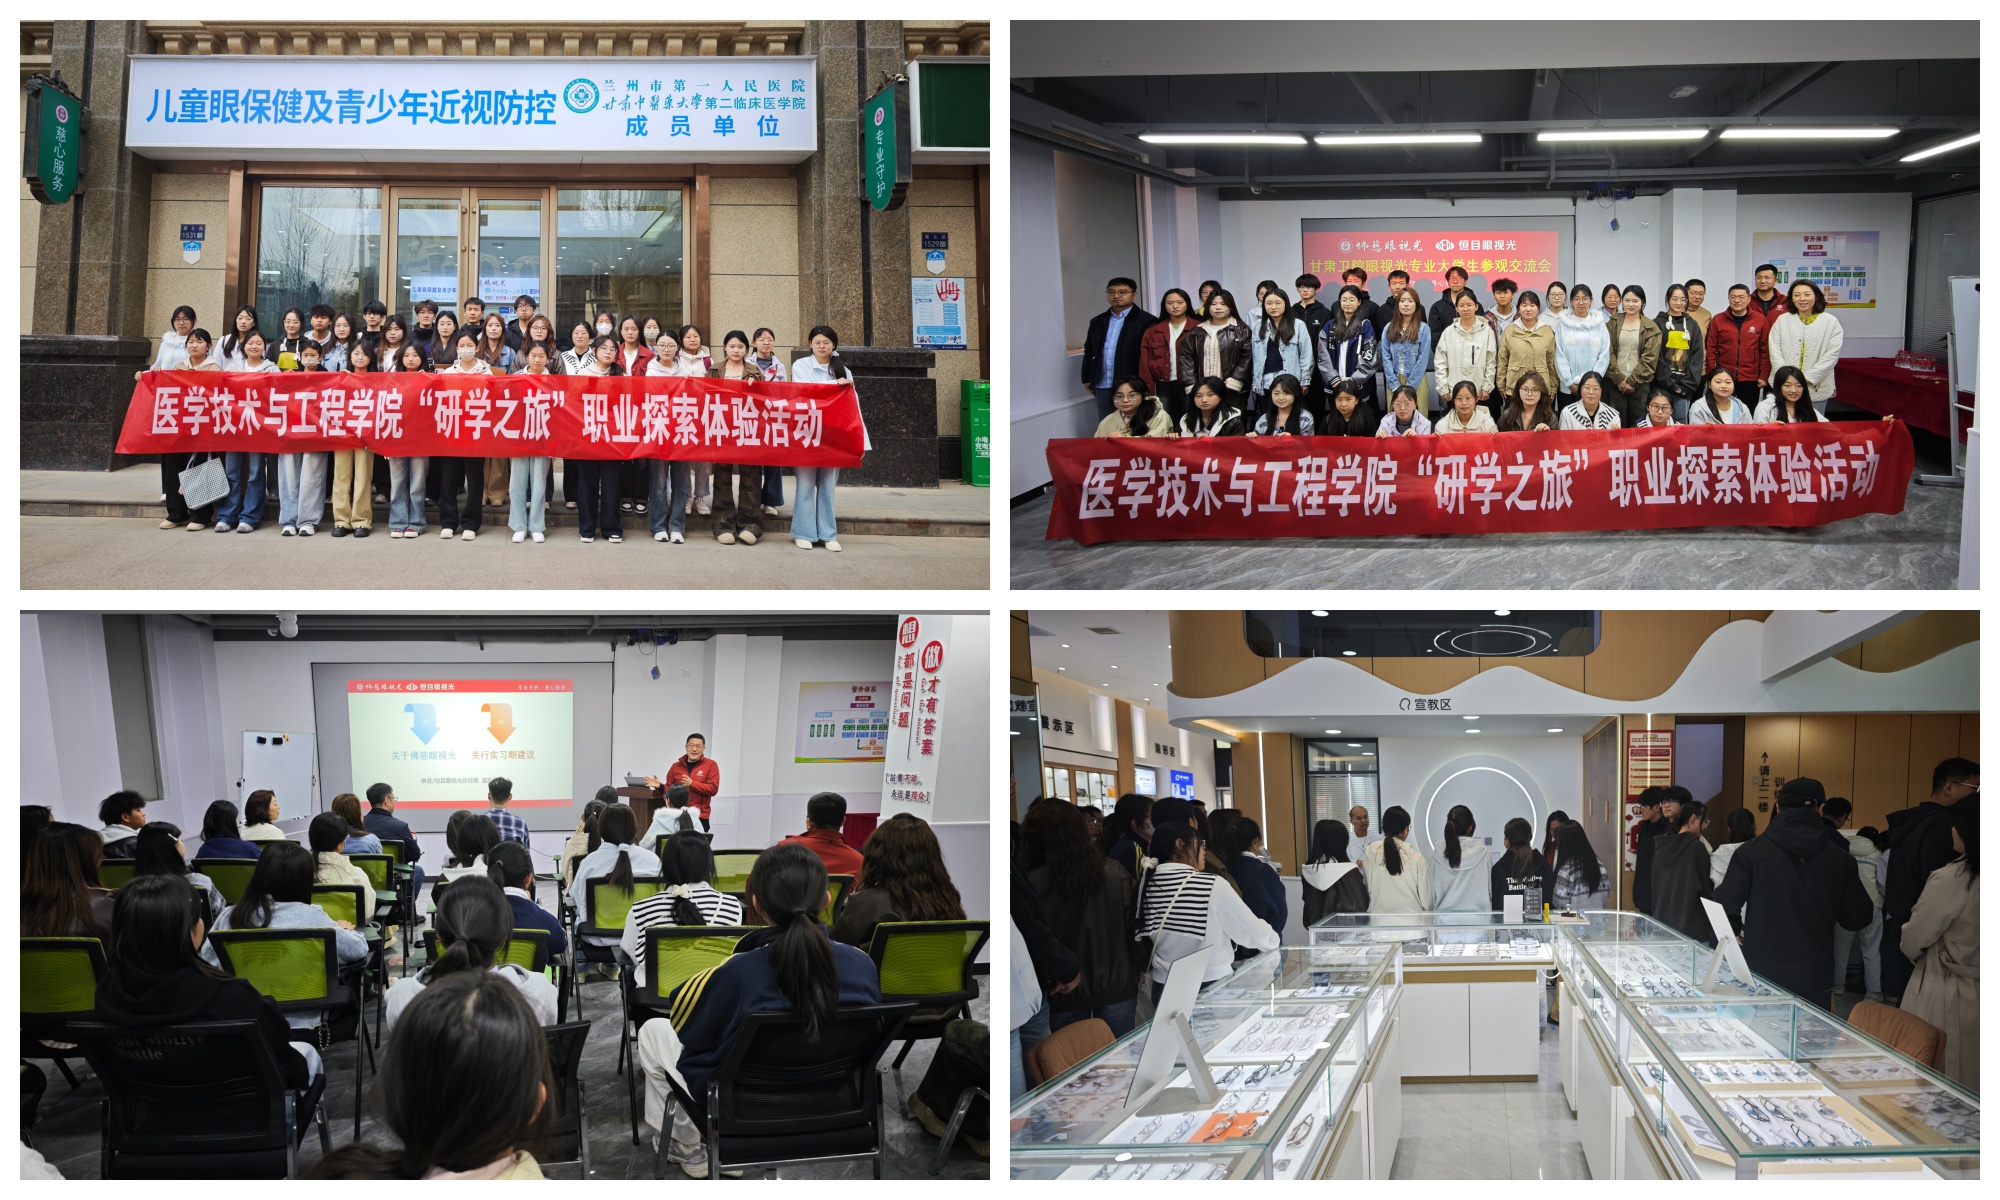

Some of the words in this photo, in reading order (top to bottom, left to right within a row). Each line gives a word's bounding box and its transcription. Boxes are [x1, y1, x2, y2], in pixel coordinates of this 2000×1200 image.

[603, 78, 806, 93] 兰州市第一人民医院
[146, 87, 557, 126] 儿童眼保健及青少年近视防控
[625, 114, 780, 137] 成员单位
[52, 125, 67, 192] 慈心服务
[875, 129, 886, 199] 专业守护
[1458, 239, 1517, 251] 恒目眼视光
[1309, 258, 1552, 273] 甘肃卫院眼视光专业大学生参观交流会
[902, 620, 917, 645] 想
[924, 645, 941, 670] 做
[1414, 698, 1452, 711] 宣教区
[391, 750, 457, 761] 关于佛慈眼视光
[1758, 765, 1770, 813] 请上二楼
[1508, 883, 1527, 891] Battle
